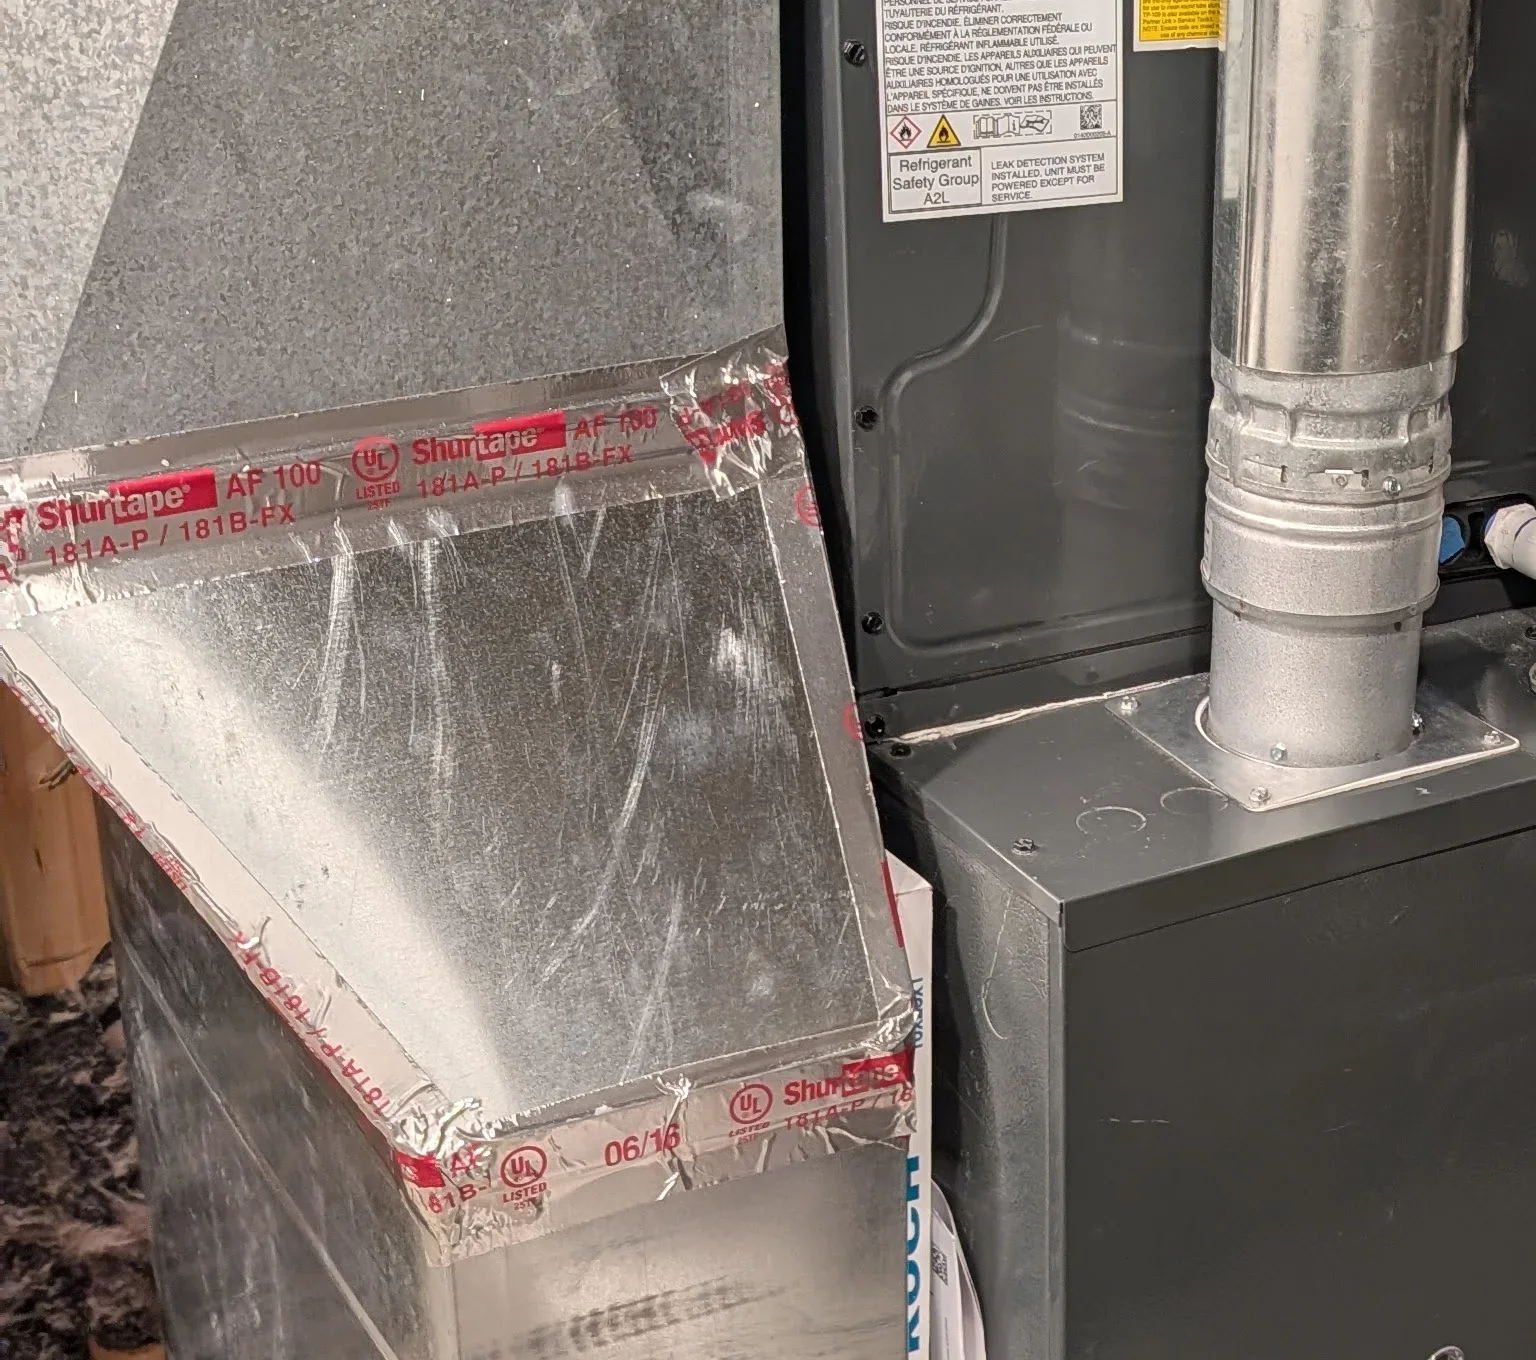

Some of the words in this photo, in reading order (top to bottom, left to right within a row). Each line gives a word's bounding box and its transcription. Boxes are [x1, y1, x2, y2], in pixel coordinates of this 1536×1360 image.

[899, 155, 972, 174] Refrigerant
[991, 161, 1014, 170] LEAK
[1017, 157, 1067, 168] DETECTION
[1070, 153, 1104, 164] SYSTEM
[991, 169, 1042, 180] INSTALLED.
[1045, 167, 1065, 176] UNIT
[1067, 165, 1092, 174] MUST
[1094, 164, 1105, 172] BE
[893, 176, 934, 191] Safety
[938, 174, 979, 189] Group
[991, 181, 1037, 192] POWERED
[1040, 177, 1074, 187] EXCEPT
[1077, 175, 1094, 185] FOR
[923, 192, 950, 205] A2L
[991, 191, 1033, 202] SERVICE.
[227, 469, 264, 499] AF
[277, 460, 321, 490] 100
[417, 468, 505, 499] 181A-P
[356, 480, 400, 499] LISTED
[45, 529, 148, 567] 181A-P
[180, 503, 296, 541] 181B-FX
[604, 1123, 681, 1167] 06/16
[502, 1181, 547, 1203] LISTED
